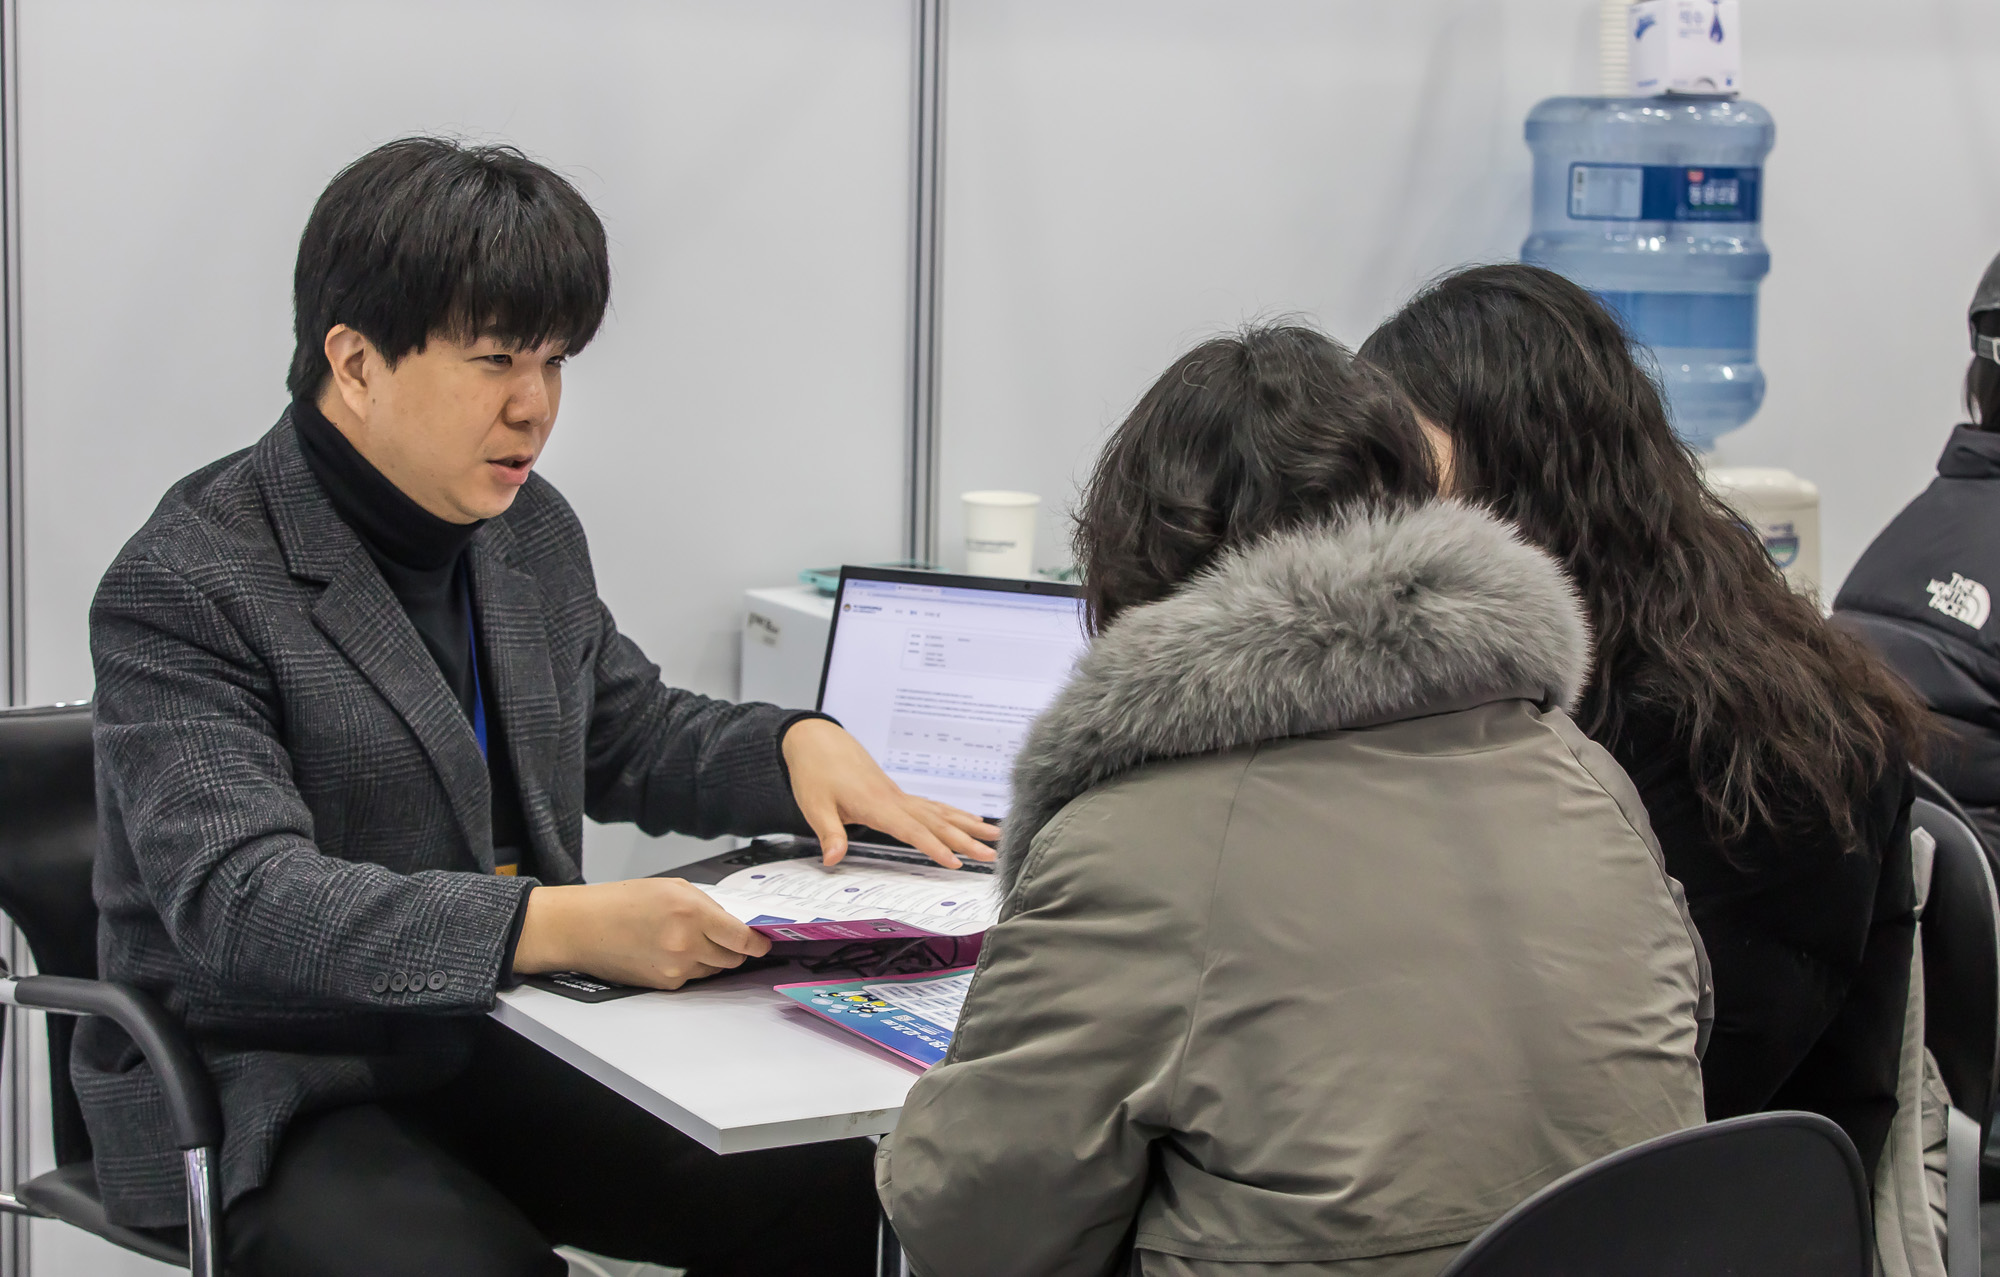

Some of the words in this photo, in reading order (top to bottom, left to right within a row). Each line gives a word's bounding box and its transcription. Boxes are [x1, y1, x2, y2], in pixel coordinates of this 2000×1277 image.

[1926, 578, 1968, 608] NORTH
[1951, 571, 1976, 594] THE
[1928, 593, 1963, 618] FACE
